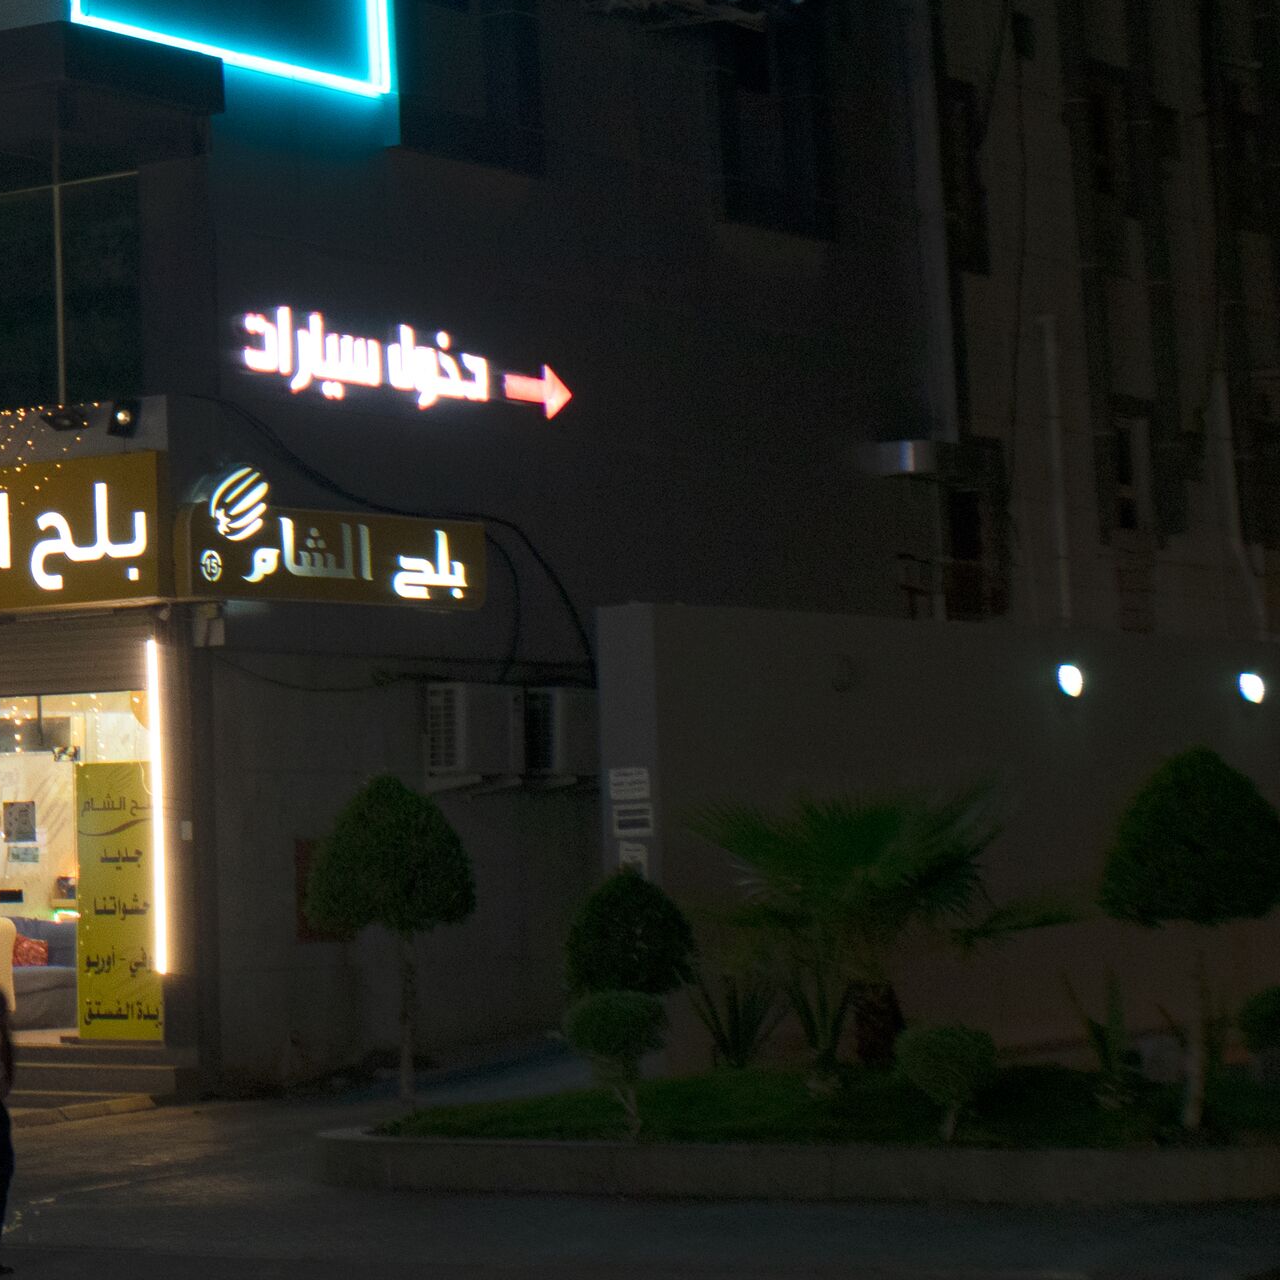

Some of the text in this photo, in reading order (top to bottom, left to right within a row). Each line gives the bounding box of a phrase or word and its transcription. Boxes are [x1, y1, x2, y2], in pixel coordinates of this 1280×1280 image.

[244, 305, 490, 410] دخول سيارات
[30, 482, 147, 590] بلح
[242, 517, 468, 599] بلح الشام
[80, 793, 126, 817] الشام
